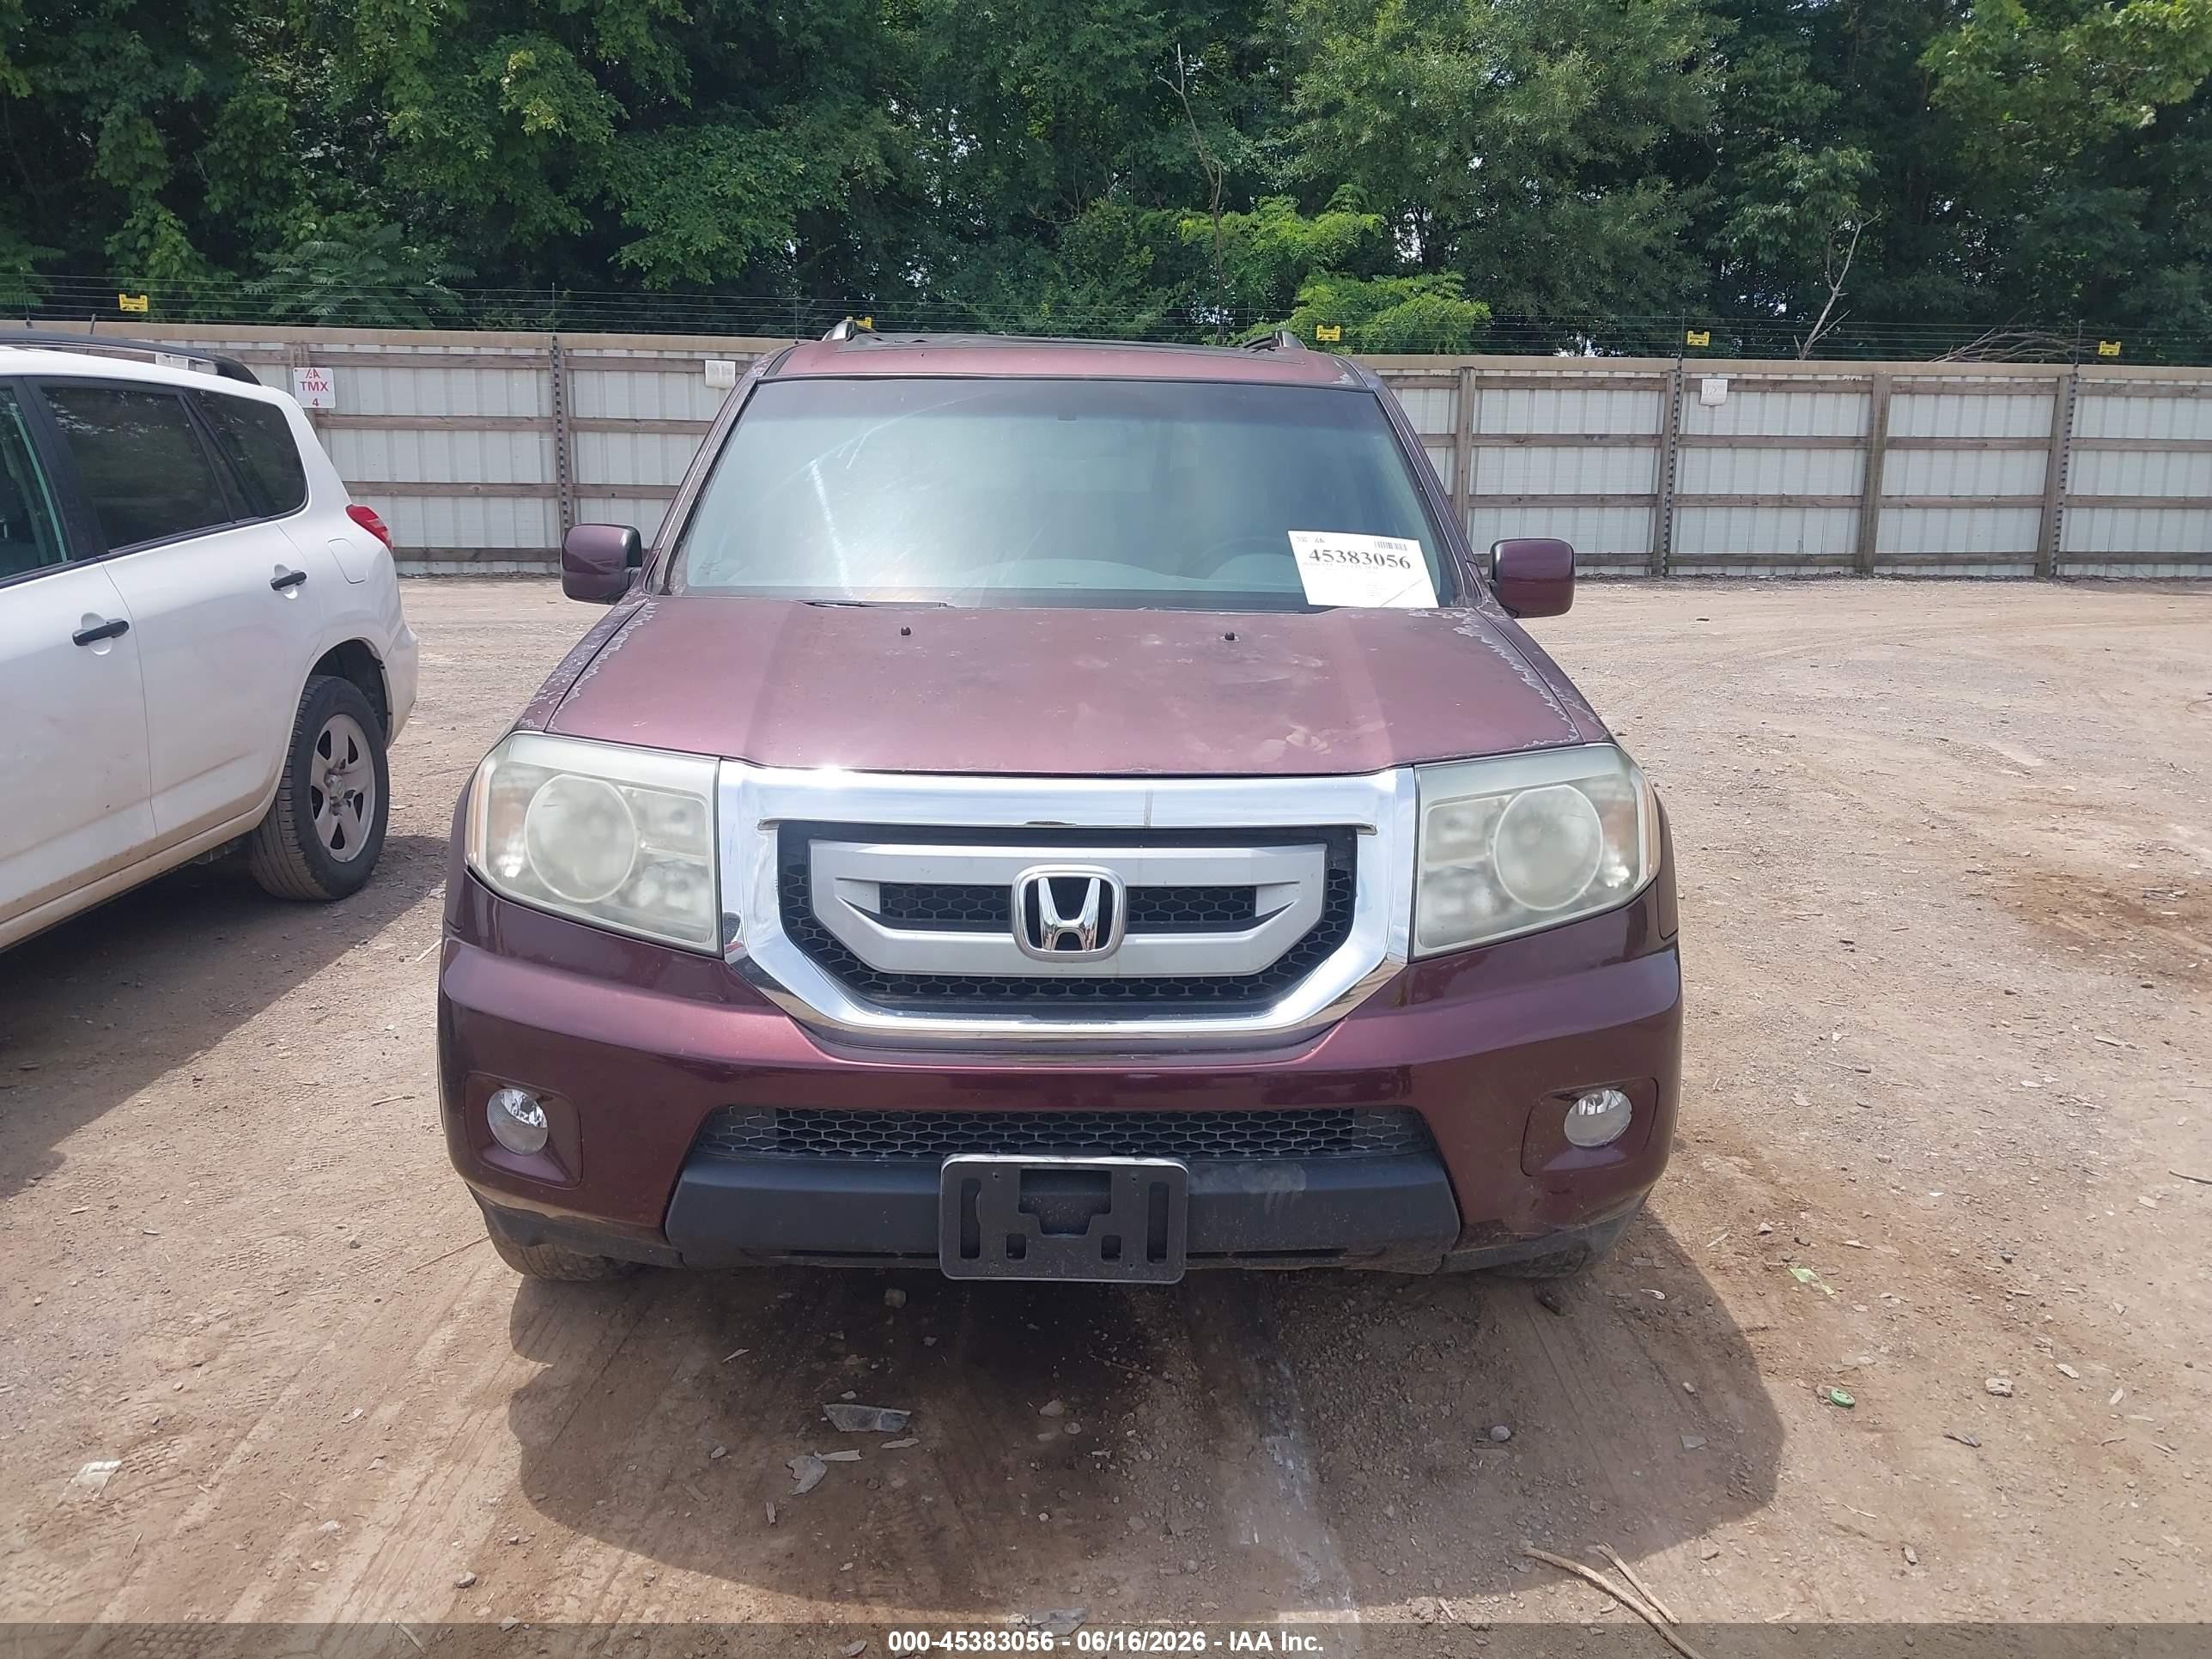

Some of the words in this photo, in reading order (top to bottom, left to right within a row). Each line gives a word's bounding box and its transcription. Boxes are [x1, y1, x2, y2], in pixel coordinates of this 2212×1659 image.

[300, 381, 329, 392] TMX
[312, 398, 319, 407] 4
[1309, 549, 1411, 569] 45383056
